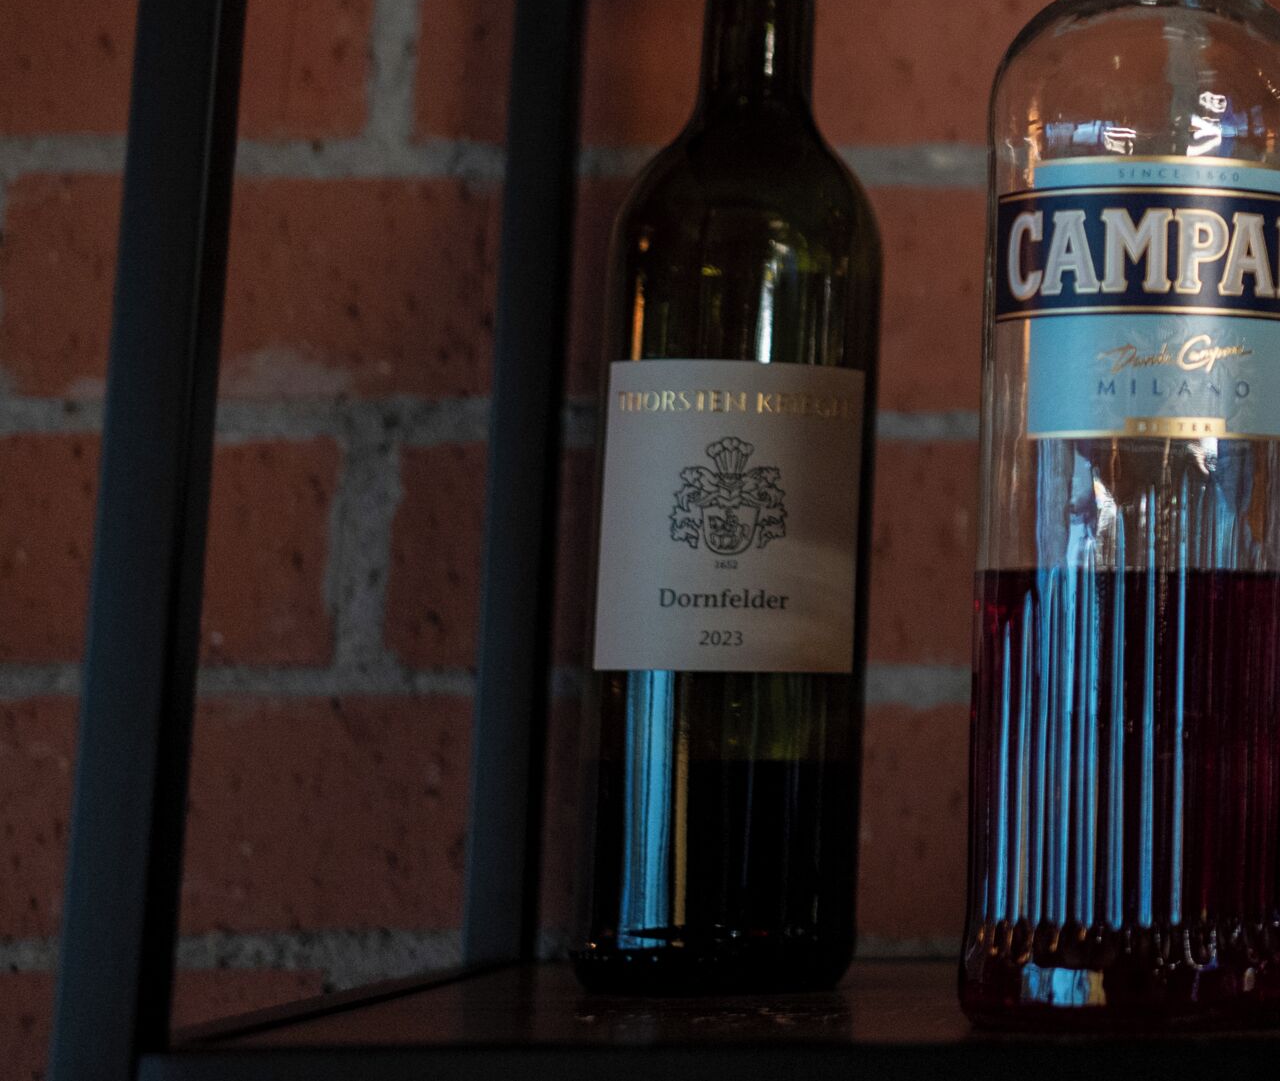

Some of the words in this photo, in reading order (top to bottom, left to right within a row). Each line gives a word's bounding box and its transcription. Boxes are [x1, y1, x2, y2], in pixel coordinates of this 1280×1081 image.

[1118, 168, 1181, 179] SINCE
[1098, 380, 1251, 398] MILANO
[1139, 420, 1213, 434] BITER
[659, 588, 789, 610] Dornfelder
[699, 630, 744, 646] 2023
